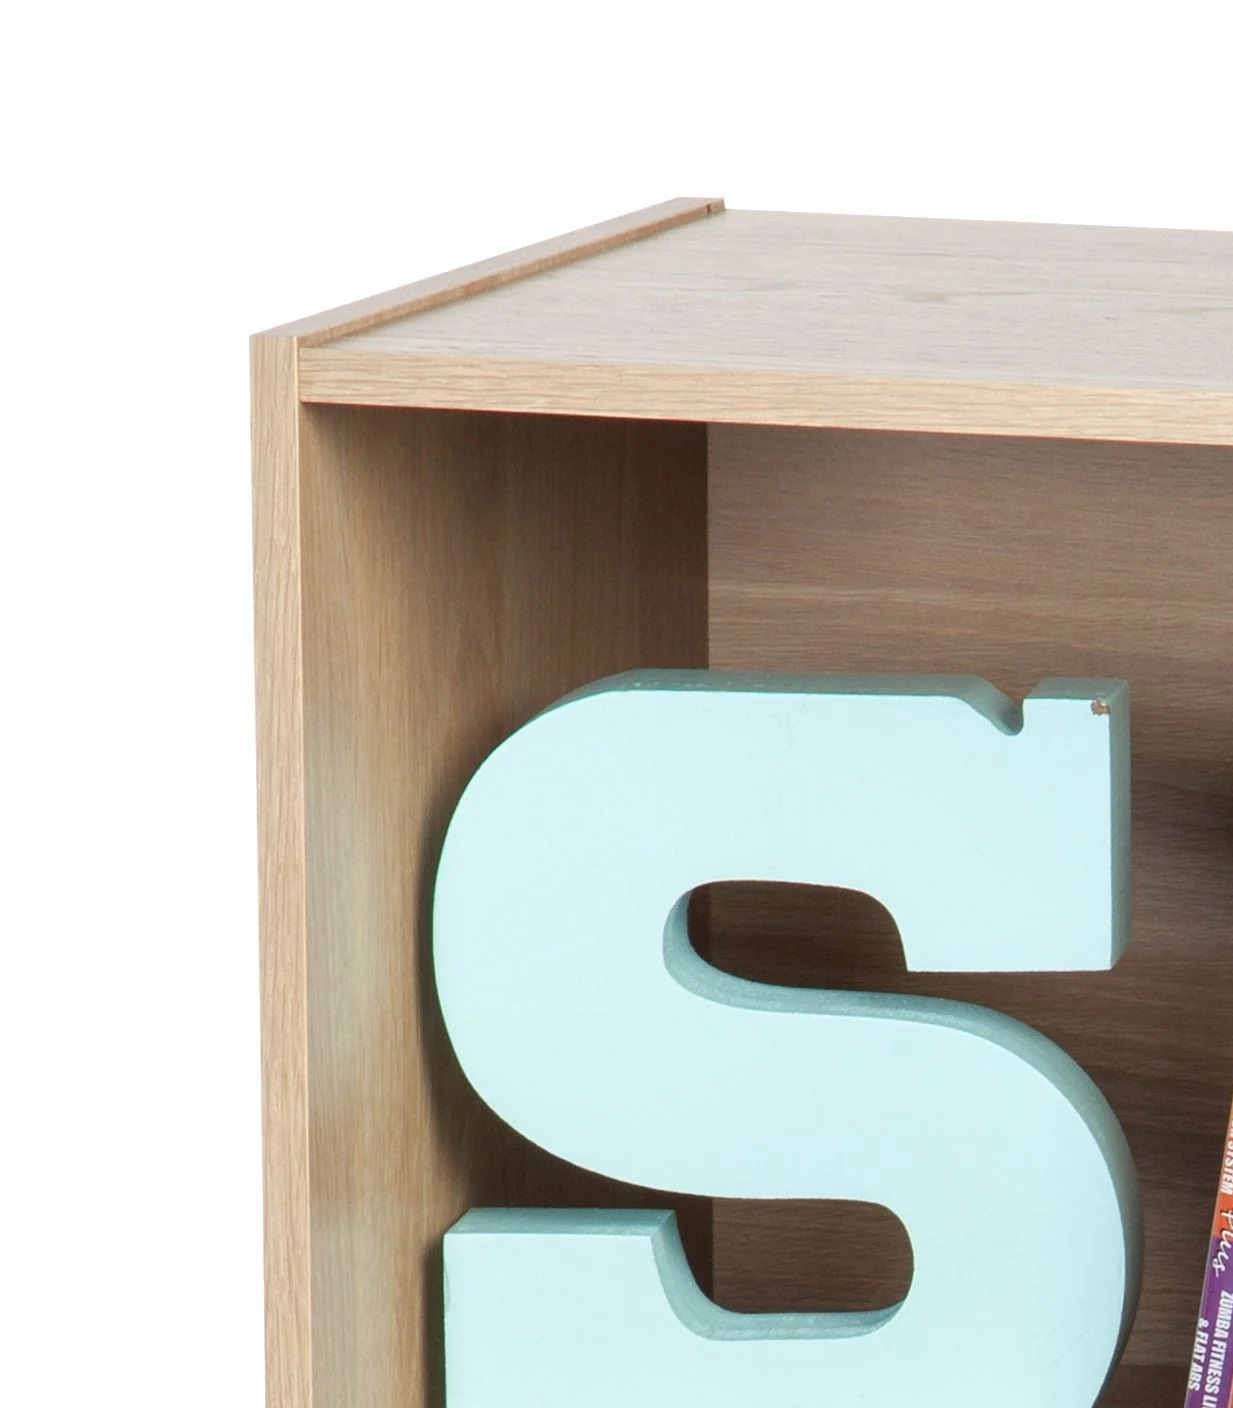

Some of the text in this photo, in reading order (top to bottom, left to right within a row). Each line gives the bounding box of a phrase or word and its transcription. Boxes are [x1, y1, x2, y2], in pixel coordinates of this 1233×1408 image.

[1187, 1317, 1210, 1391] & FLAT ABS
[1204, 1337, 1228, 1394] FITNESS
